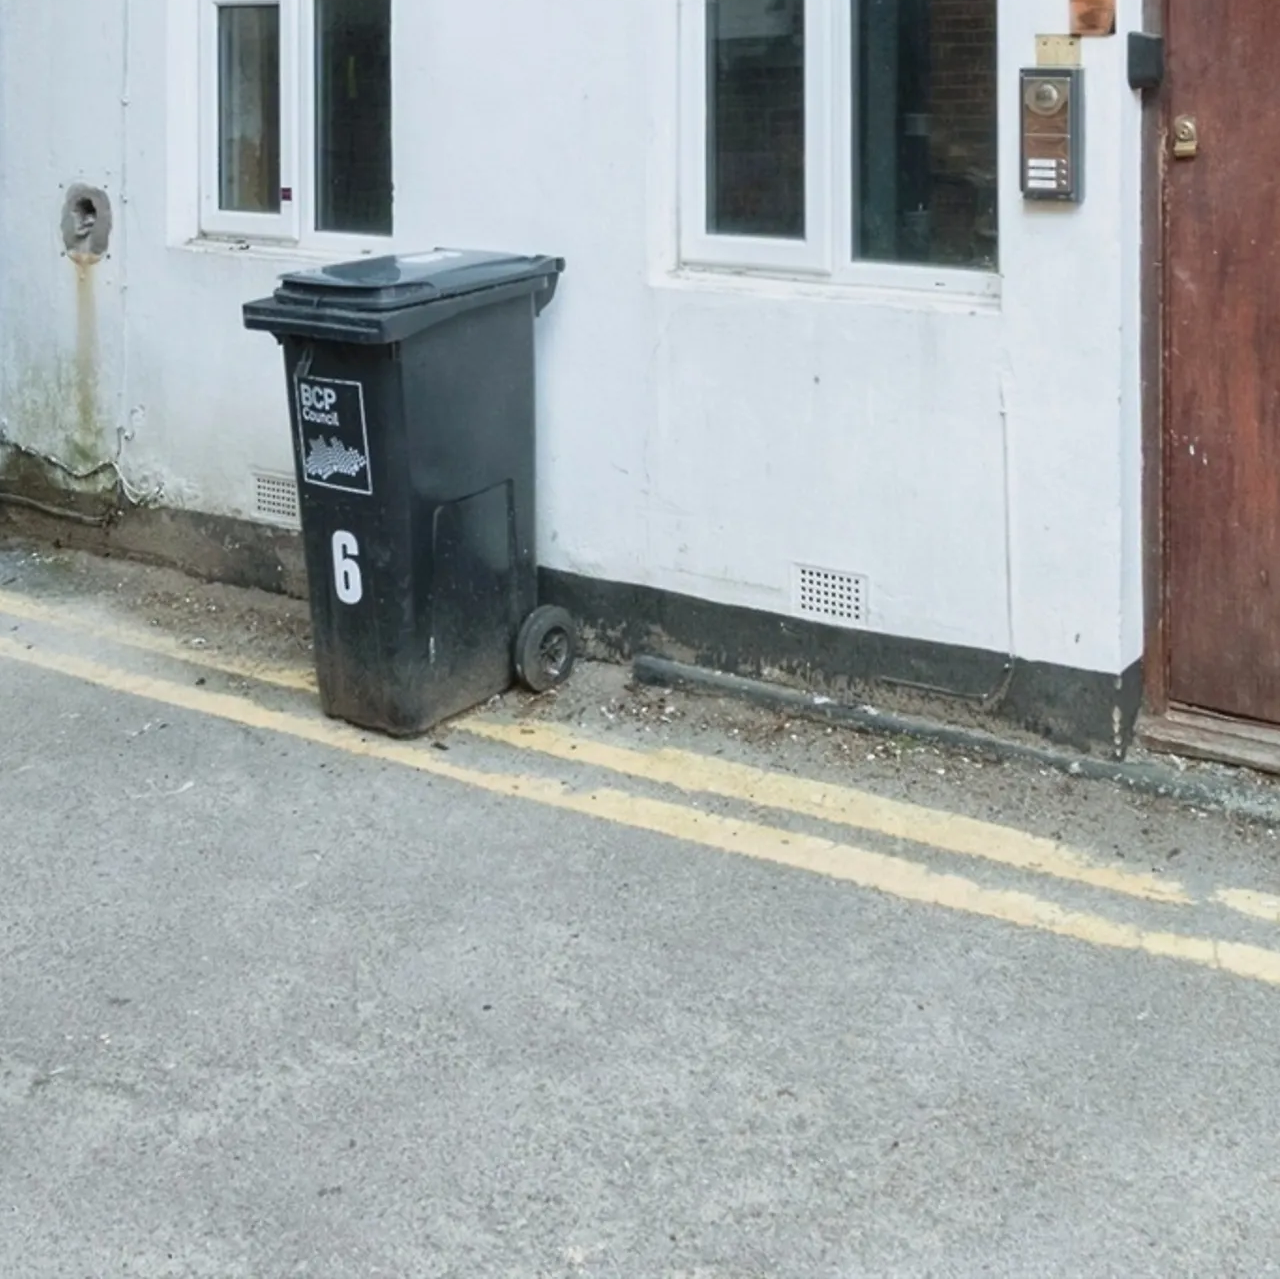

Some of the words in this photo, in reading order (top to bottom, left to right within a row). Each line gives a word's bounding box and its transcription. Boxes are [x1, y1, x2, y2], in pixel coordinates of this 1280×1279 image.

[300, 384, 337, 411] BCP
[302, 408, 339, 426] Council
[332, 530, 363, 605] 6
